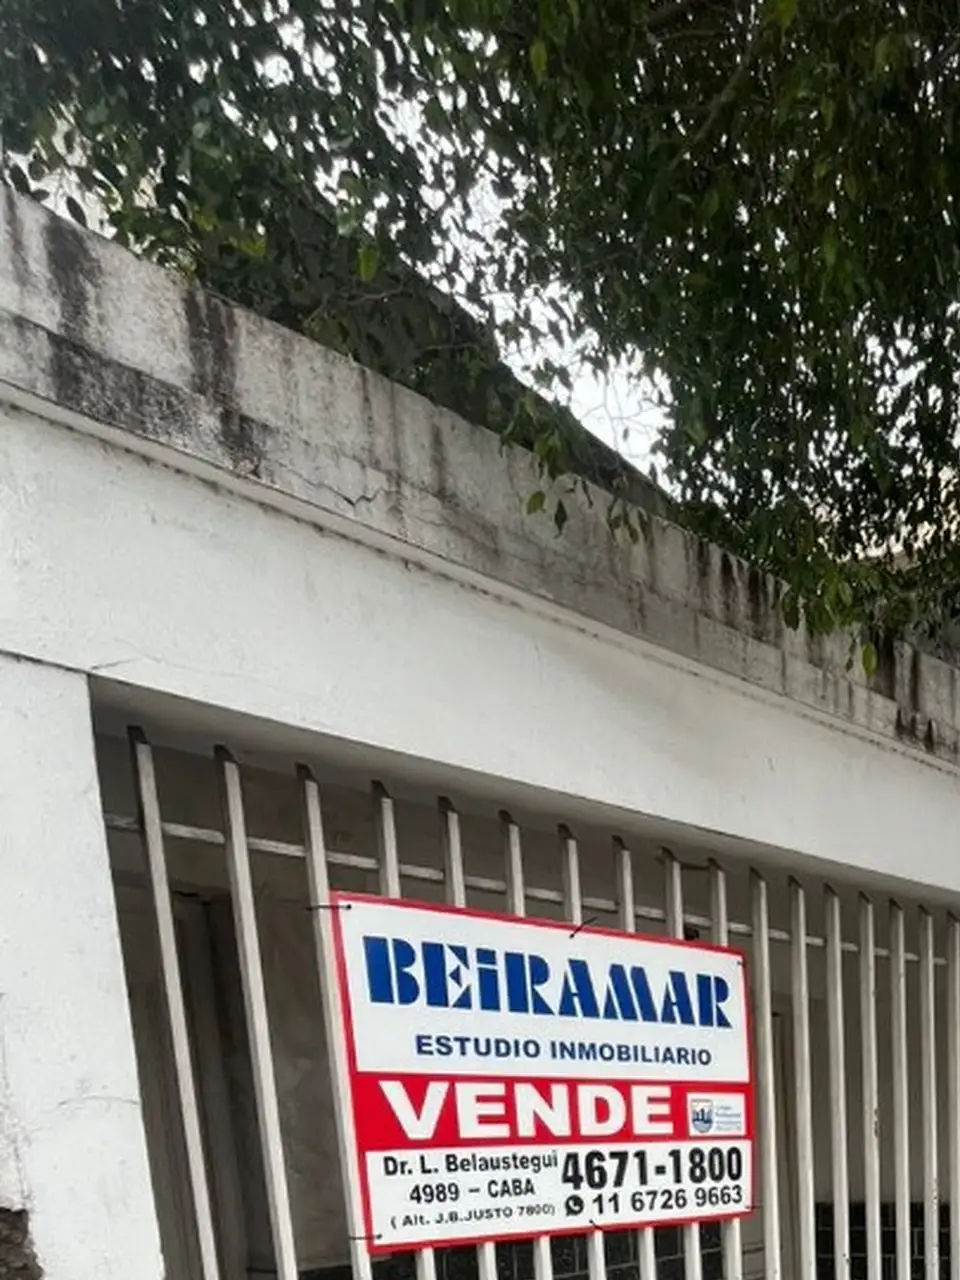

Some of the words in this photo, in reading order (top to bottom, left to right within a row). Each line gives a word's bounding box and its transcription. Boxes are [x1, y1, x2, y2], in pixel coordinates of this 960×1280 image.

[415, 1034, 541, 1059] ESTUDIO
[550, 1041, 712, 1066] INMOBILIARIO
[378, 1080, 674, 1140] VENDE
[383, 1155, 413, 1176] Dr.
[420, 1154, 439, 1174] L.
[445, 1150, 558, 1174] Belaustegui
[562, 1146, 742, 1190] 4671-1800
[409, 1182, 460, 1204] 4989
[487, 1178, 536, 1198] CABA
[592, 1193, 619, 1214] 11
[631, 1188, 688, 1212] 6726
[694, 1184, 743, 1207] 9663
[402, 1213, 430, 1227] Alt.
